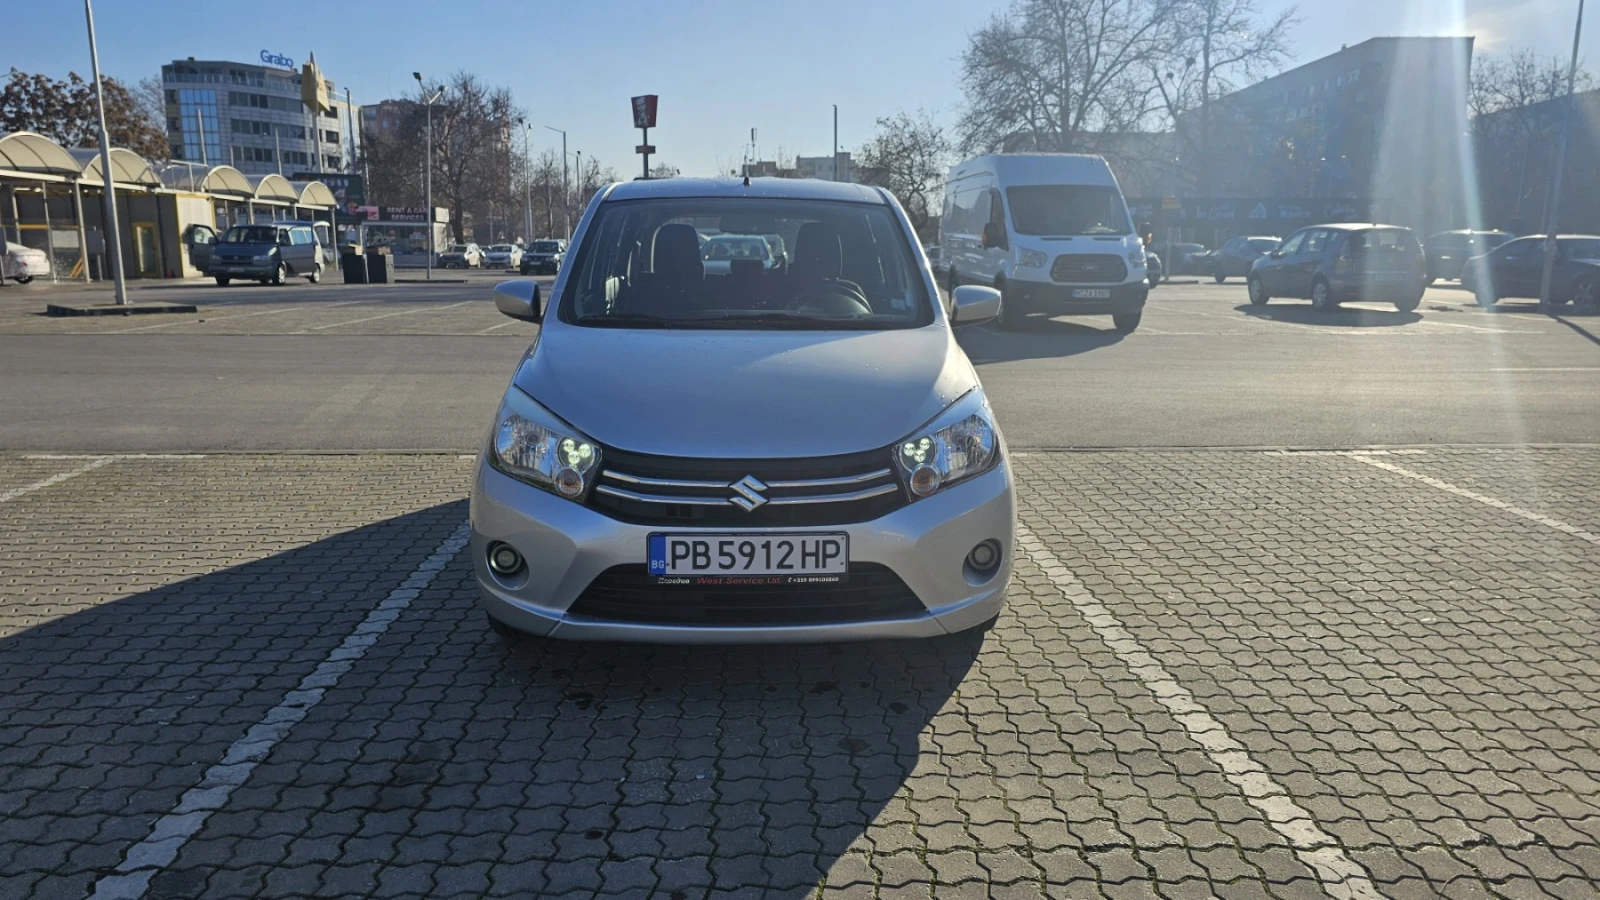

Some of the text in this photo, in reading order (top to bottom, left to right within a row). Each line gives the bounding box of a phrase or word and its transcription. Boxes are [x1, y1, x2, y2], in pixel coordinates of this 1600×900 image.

[260, 49, 294, 68] Grabo
[671, 539, 841, 569] PB 5912 HP
[652, 560, 664, 568] BG
[697, 577, 722, 585] West
